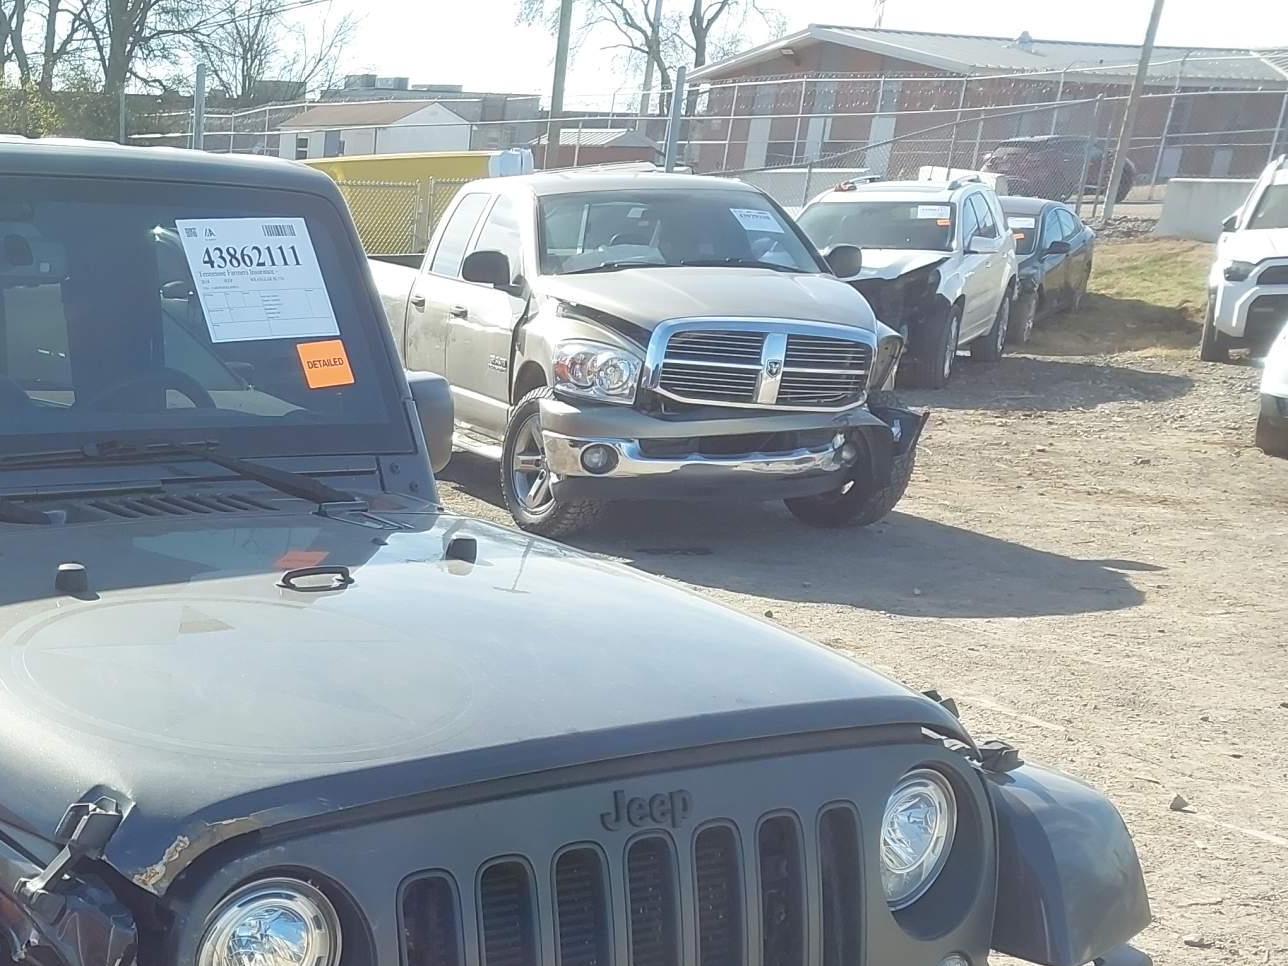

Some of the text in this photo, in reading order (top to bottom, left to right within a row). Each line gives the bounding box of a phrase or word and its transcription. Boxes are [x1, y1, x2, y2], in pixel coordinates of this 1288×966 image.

[202, 245, 303, 269] 43862111
[307, 358, 344, 369] DETAILED
[599, 789, 693, 832] Jeep
